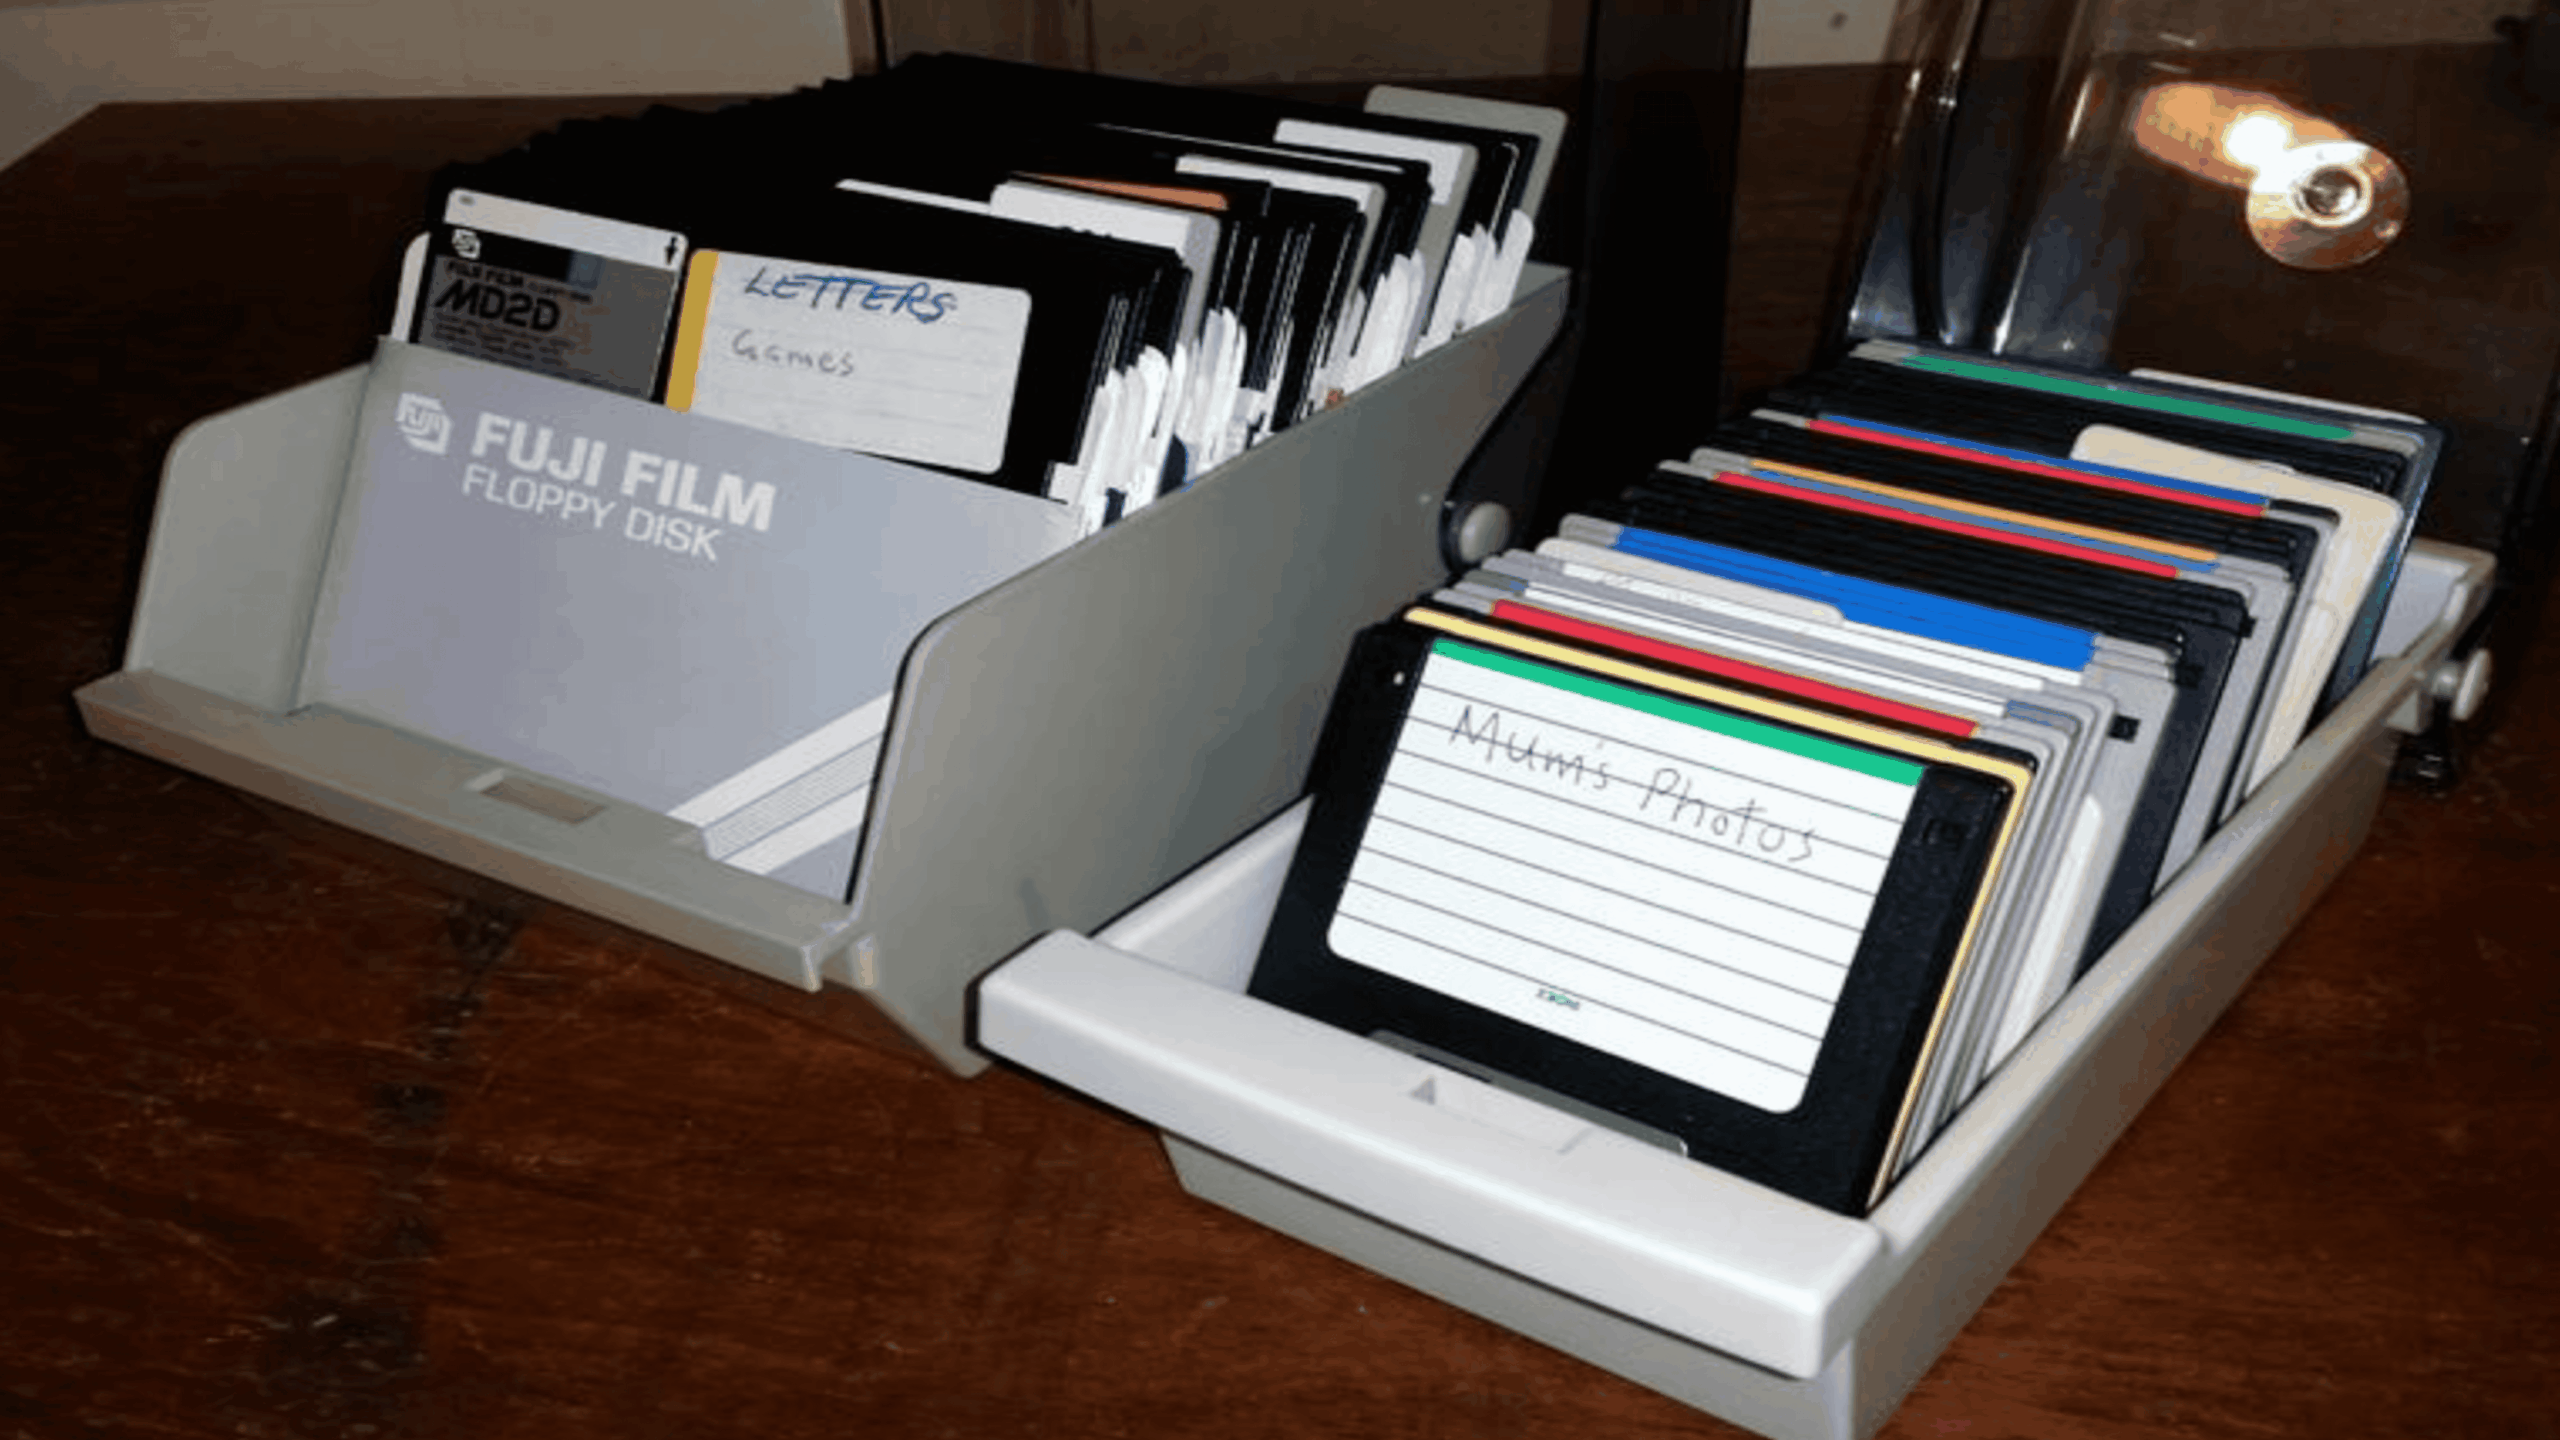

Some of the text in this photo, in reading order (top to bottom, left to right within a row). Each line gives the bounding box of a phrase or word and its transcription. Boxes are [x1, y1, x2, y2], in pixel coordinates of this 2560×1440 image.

[434, 278, 562, 333] MD2D
[744, 266, 958, 323] LETTERS
[731, 328, 854, 377] Games
[470, 411, 777, 532] FUJI FILM
[461, 463, 722, 562] FLOPPY DISK
[1448, 704, 1816, 862] Mum's Photos
